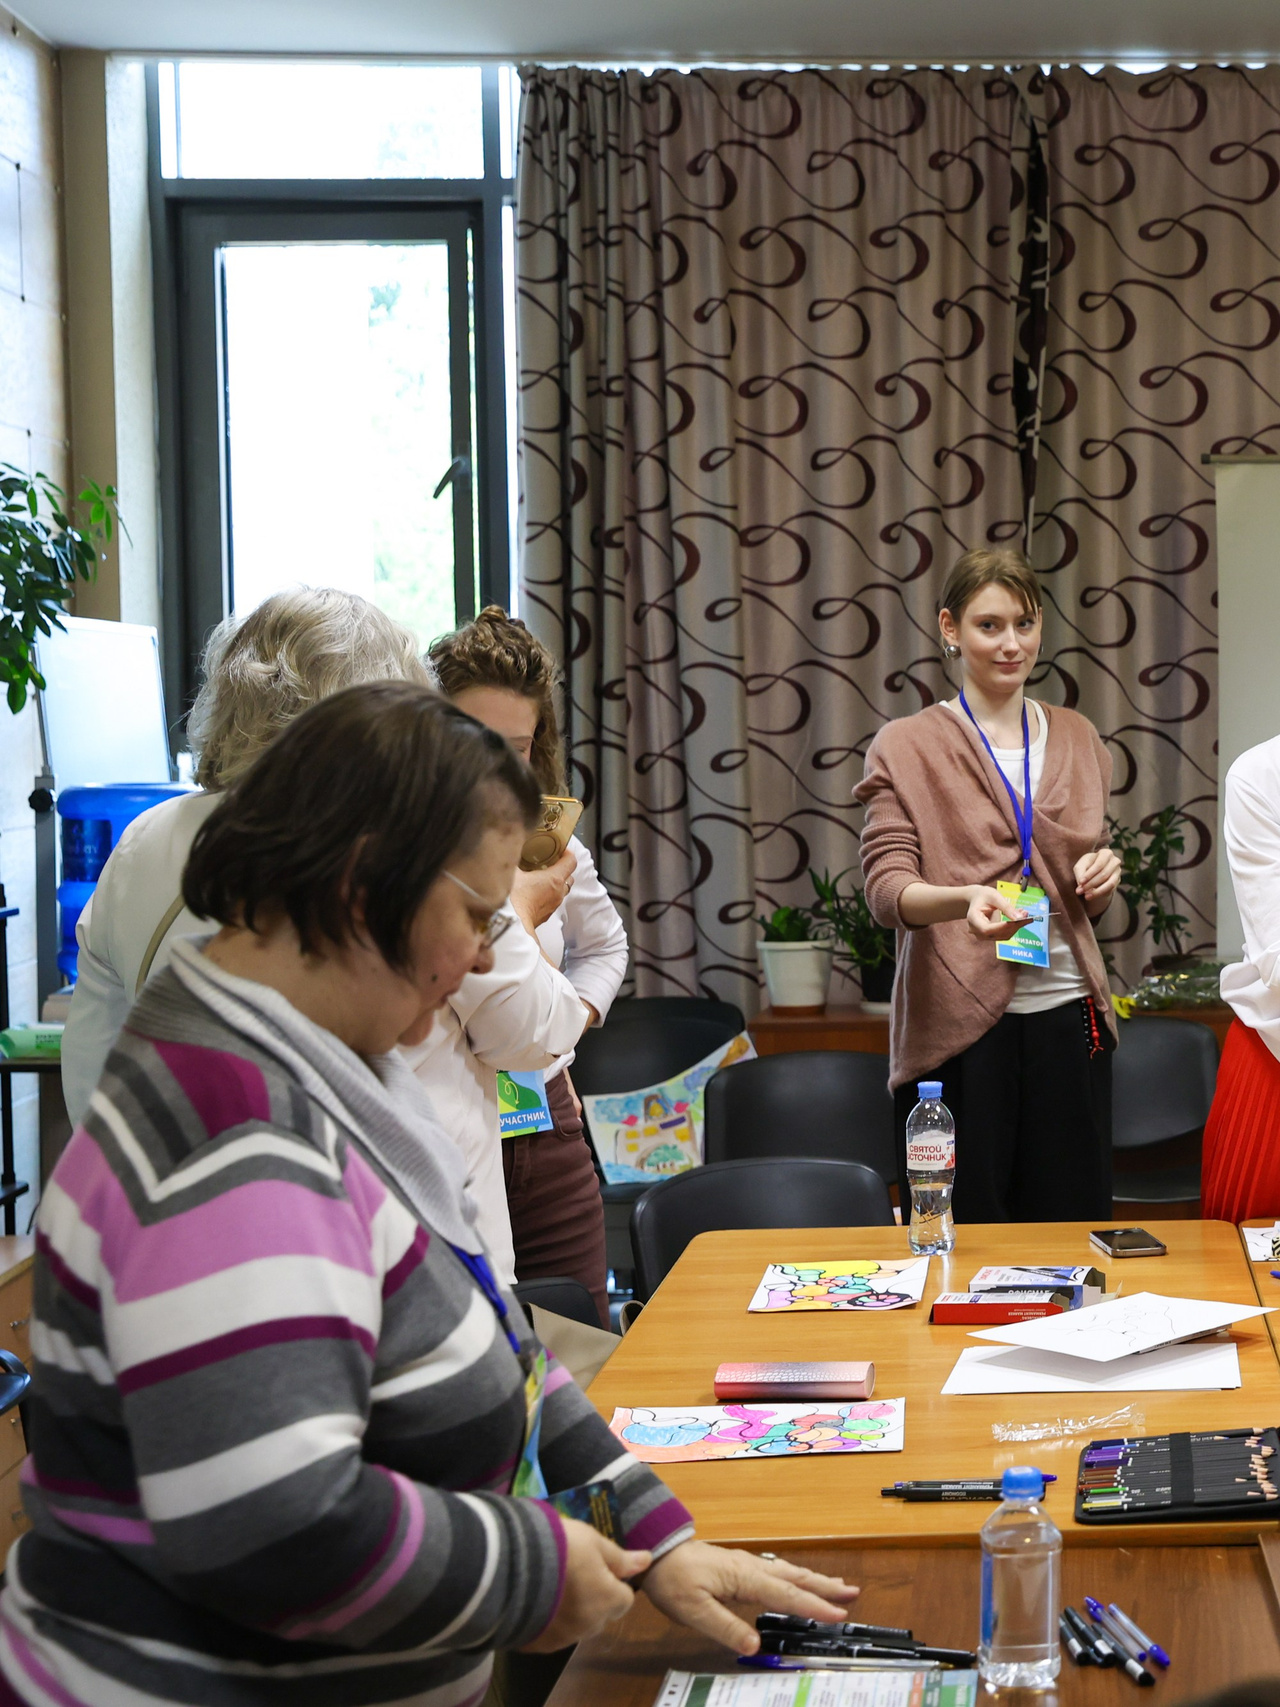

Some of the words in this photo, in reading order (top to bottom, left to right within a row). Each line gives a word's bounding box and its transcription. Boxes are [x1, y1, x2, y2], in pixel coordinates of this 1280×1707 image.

[1012, 936, 1044, 947] АНИЗАТОР
[1012, 949, 1033, 959] НИКА
[500, 1110, 546, 1127] УЧАСТНИК
